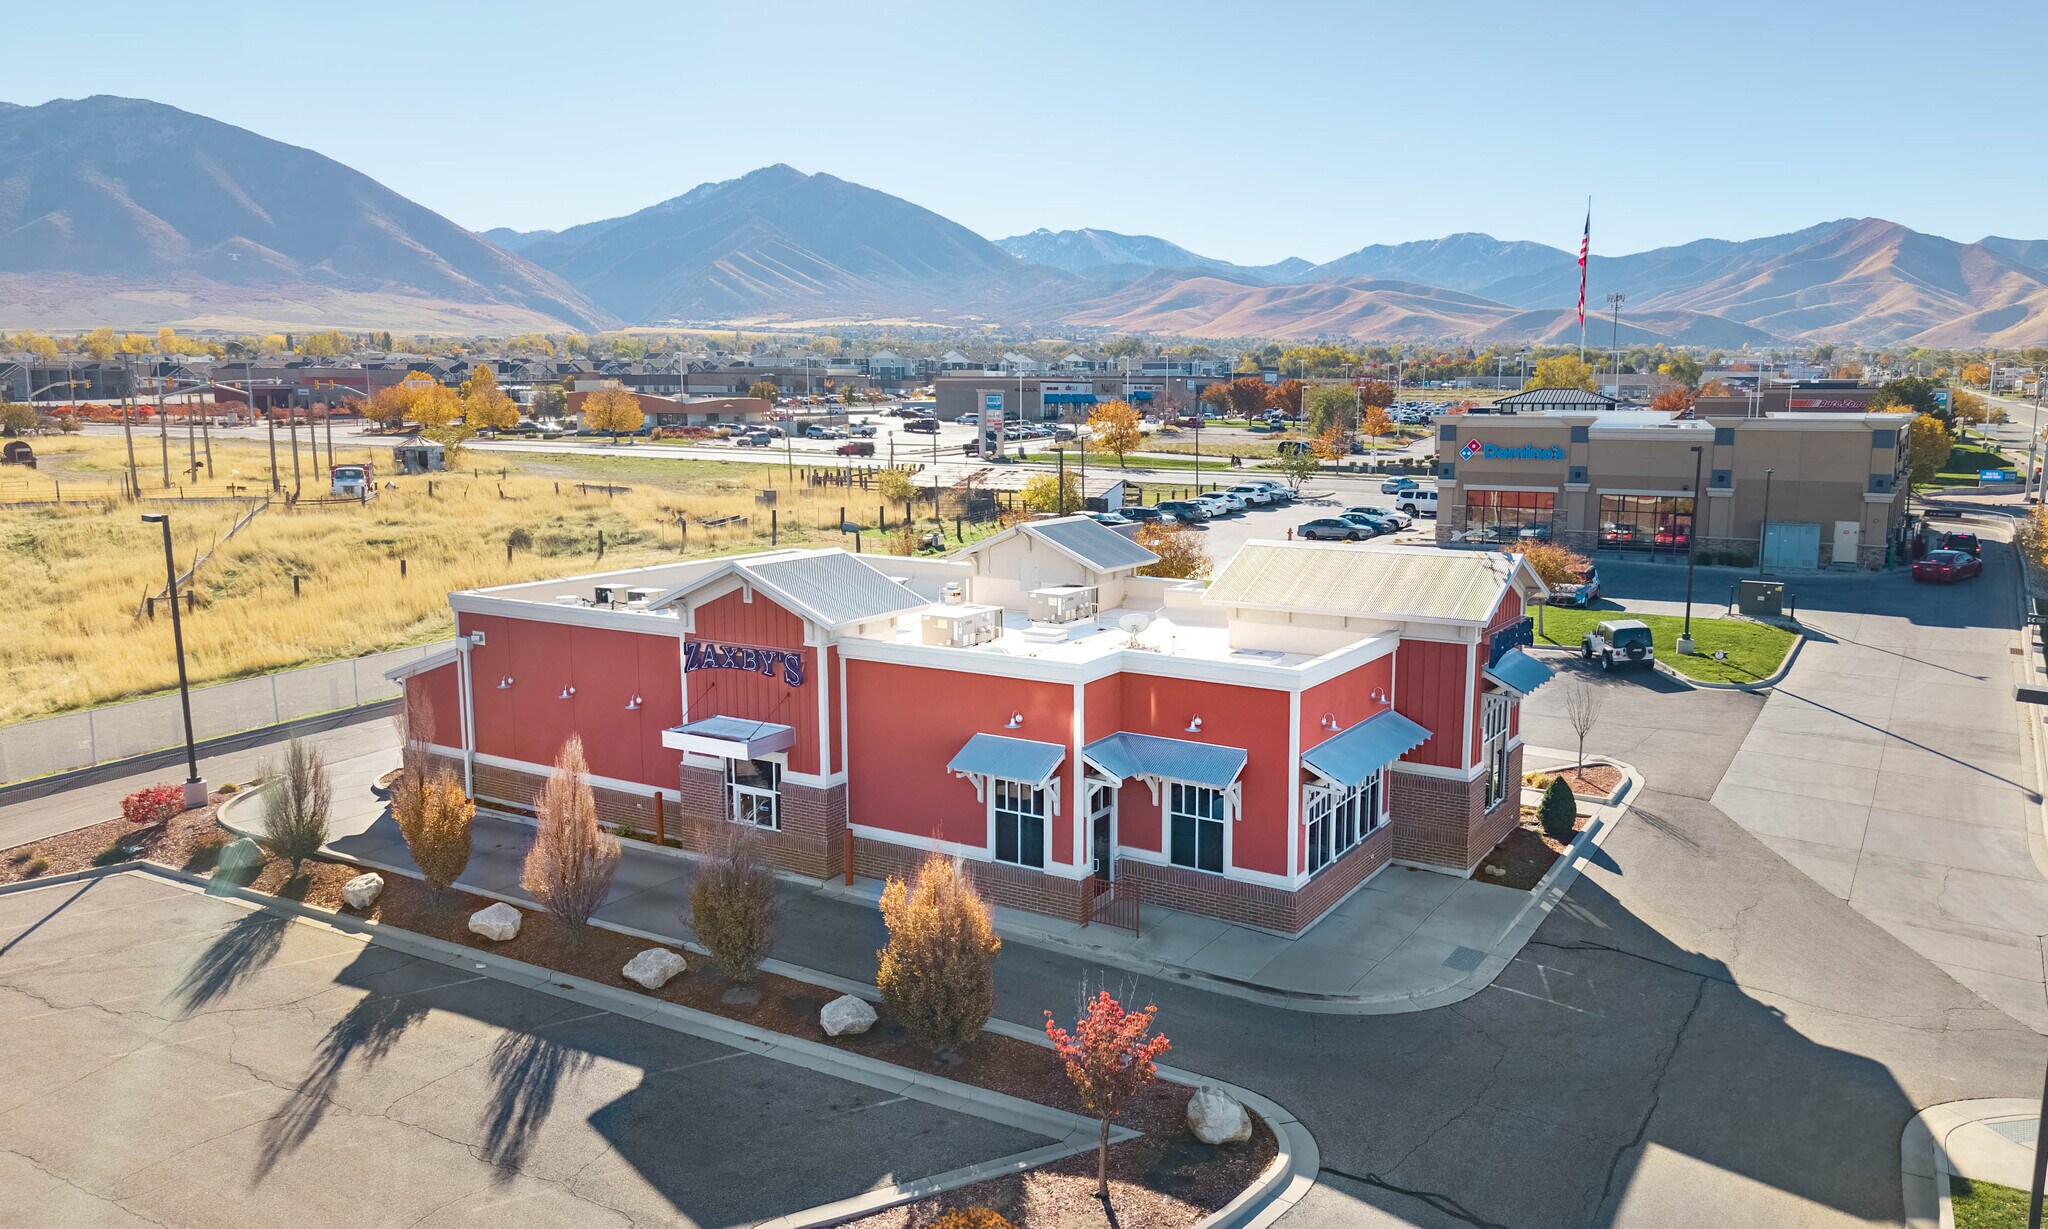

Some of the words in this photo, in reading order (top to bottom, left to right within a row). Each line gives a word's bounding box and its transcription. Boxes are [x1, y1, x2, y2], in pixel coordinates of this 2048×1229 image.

[1819, 399, 1868, 409] AutoZone
[1484, 444, 1564, 460] Domino's
[684, 642, 802, 686] ZAXBY'S
